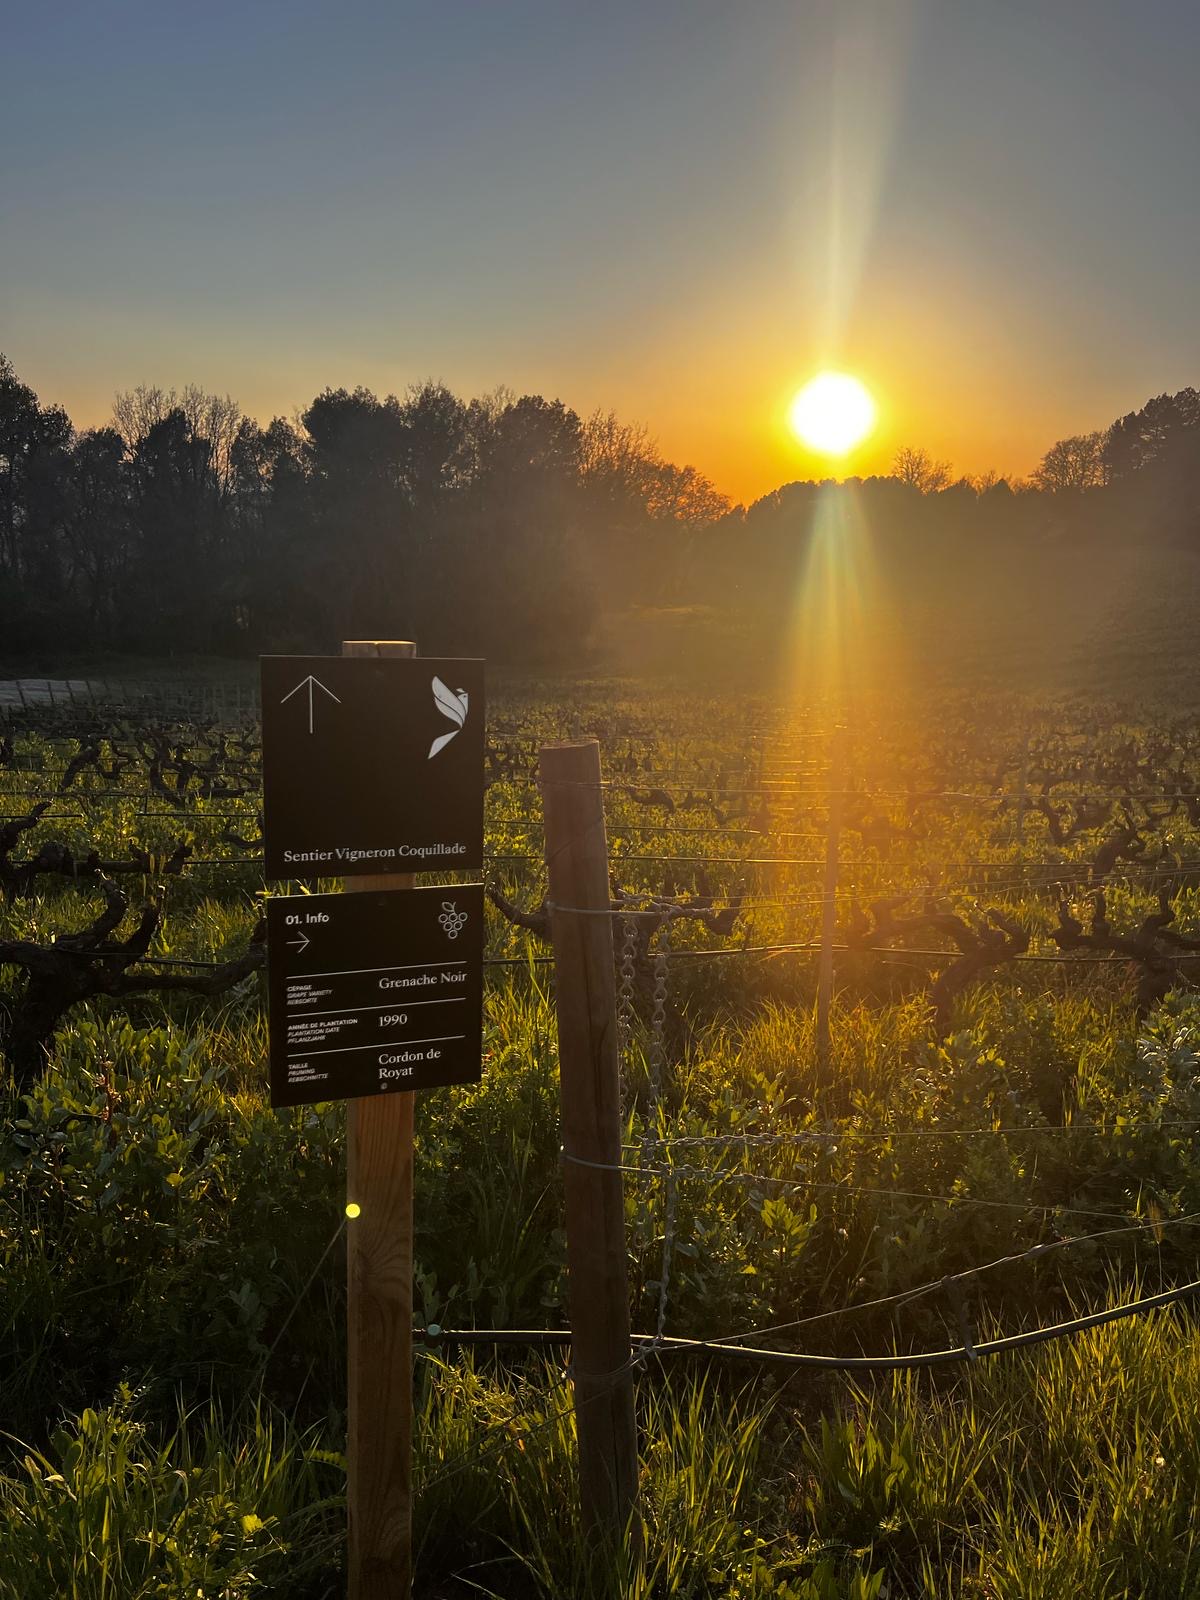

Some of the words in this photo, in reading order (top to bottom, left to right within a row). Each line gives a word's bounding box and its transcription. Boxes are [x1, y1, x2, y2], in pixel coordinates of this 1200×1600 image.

[284, 850, 334, 863] Sentier
[335, 847, 395, 862] Vigneron
[399, 843, 467, 859] Coquillade
[286, 914, 303, 925] 01.
[306, 912, 330, 924] Info
[379, 974, 438, 989] Grenache
[440, 971, 468, 984] Noir
[319, 1019, 358, 1027] PLANTATION
[379, 1013, 408, 1027] 1990
[378, 1051, 424, 1065] Cordon
[426, 1048, 441, 1059] de
[379, 1066, 414, 1080] Royat
